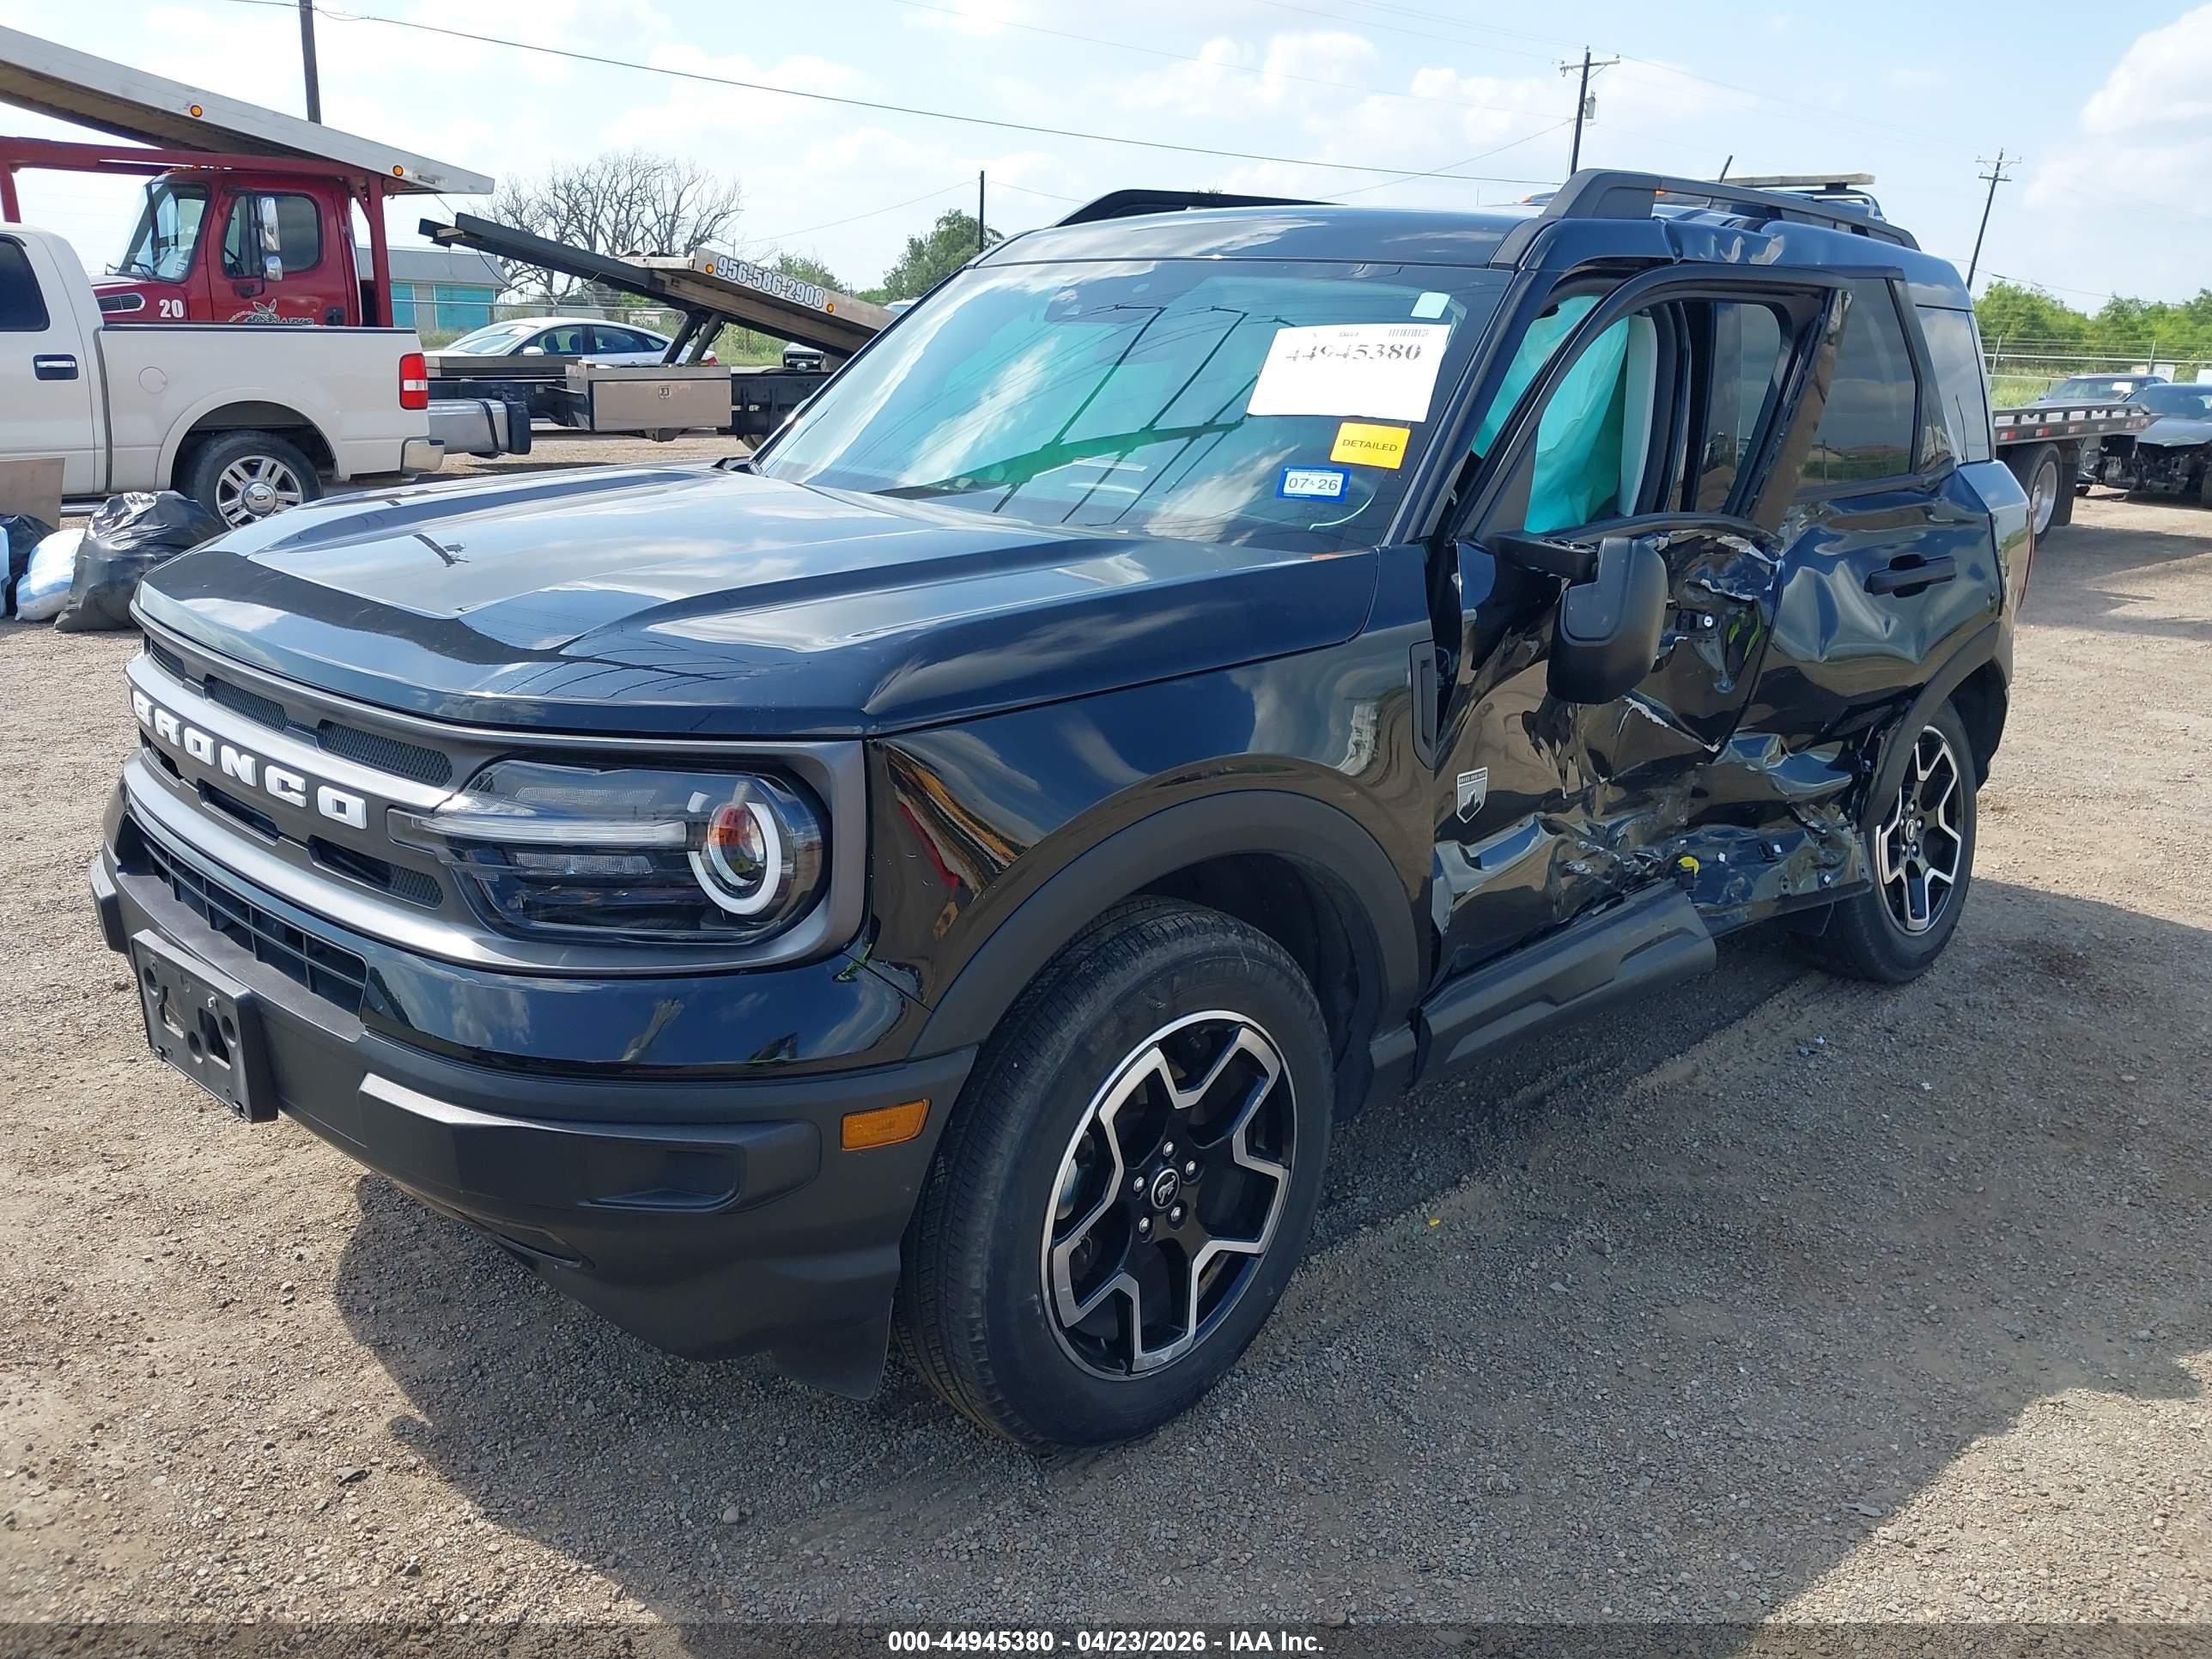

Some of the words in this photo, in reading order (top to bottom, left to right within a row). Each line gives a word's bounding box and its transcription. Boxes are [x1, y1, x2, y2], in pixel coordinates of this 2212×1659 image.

[716, 255, 824, 308] 956-586-2908
[159, 299, 184, 318] 20
[1342, 439, 1398, 452] DETAILED
[1288, 477, 1310, 489] 07
[1317, 478, 1339, 490] 26
[132, 690, 368, 830] BRONCO
